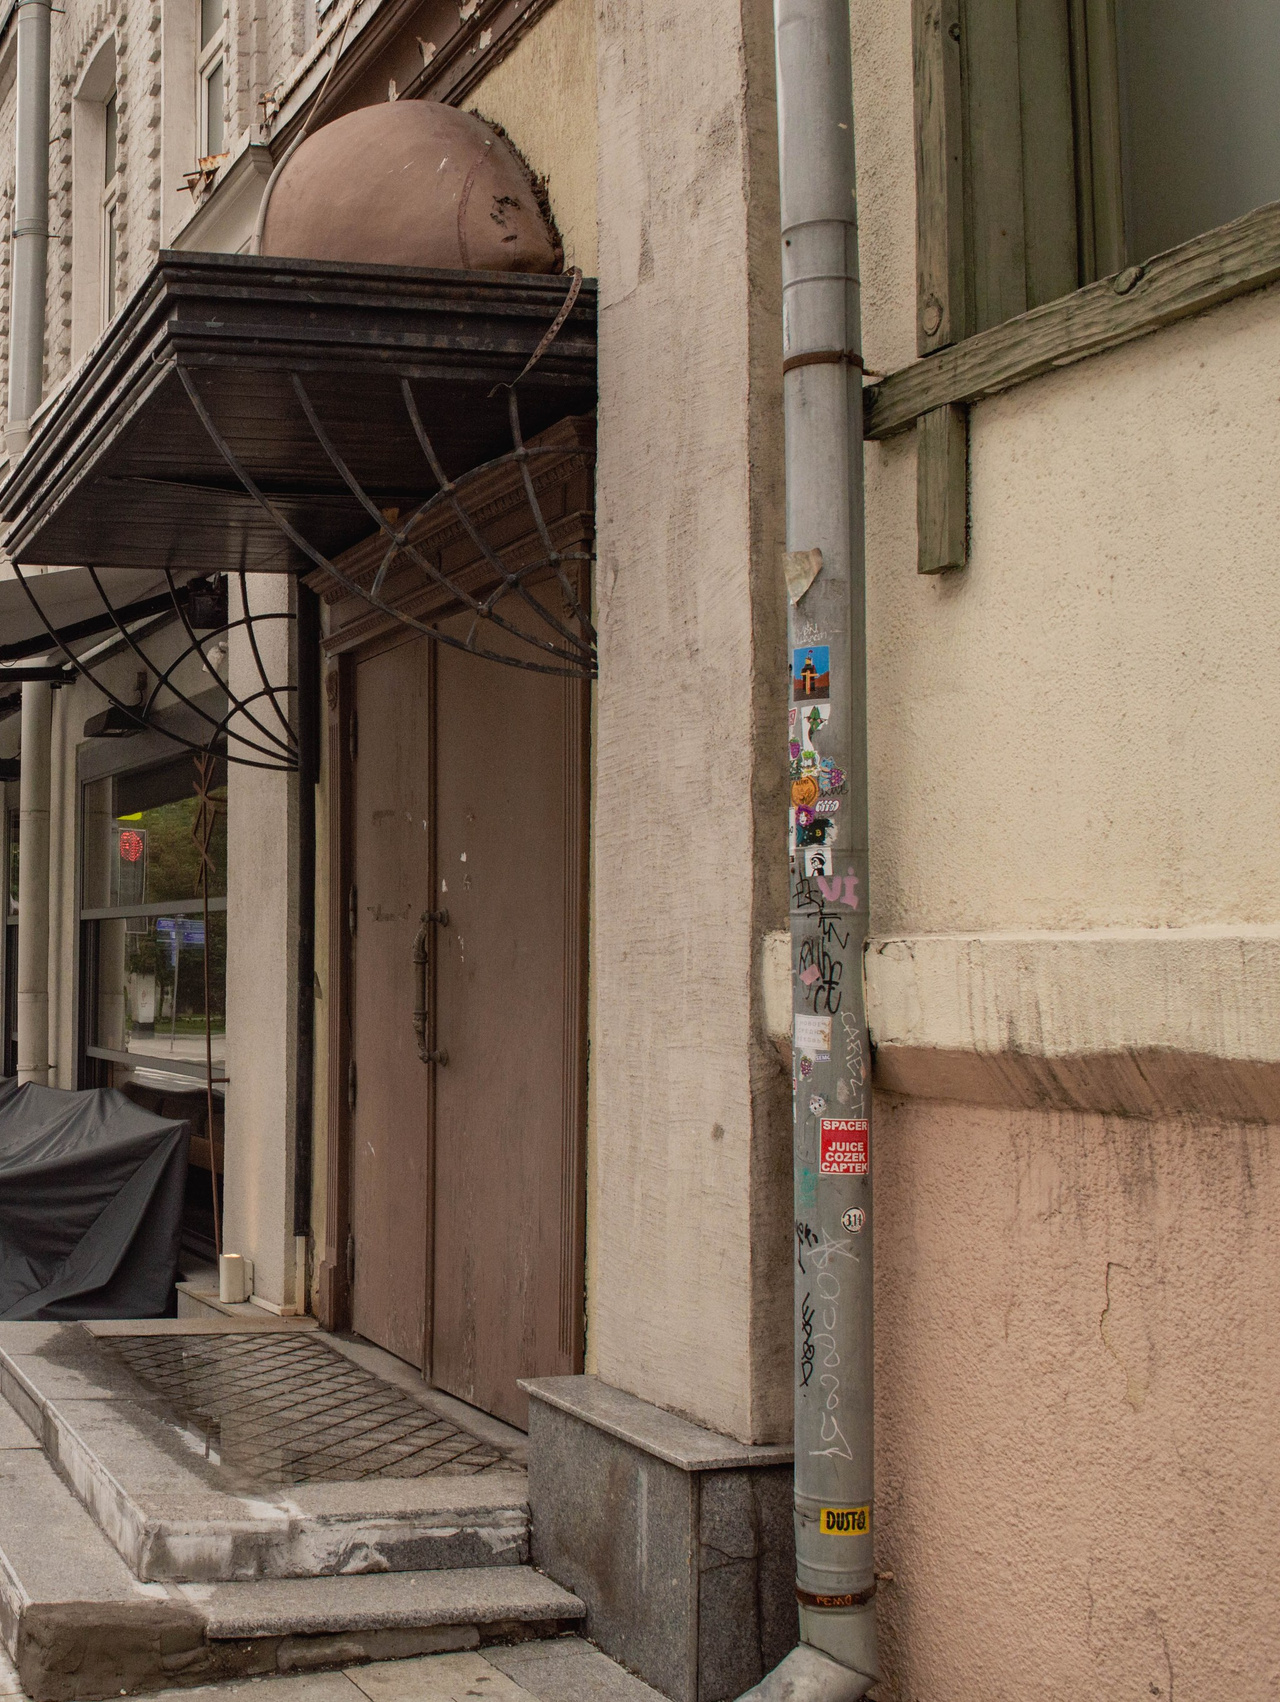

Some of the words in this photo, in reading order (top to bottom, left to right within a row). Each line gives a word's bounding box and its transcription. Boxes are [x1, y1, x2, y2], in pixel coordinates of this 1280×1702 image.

[822, 1120, 868, 1131] SPACER
[828, 1141, 864, 1152] JUICE
[825, 1151, 866, 1162] COZEK
[821, 1162, 868, 1172] CAPTEK
